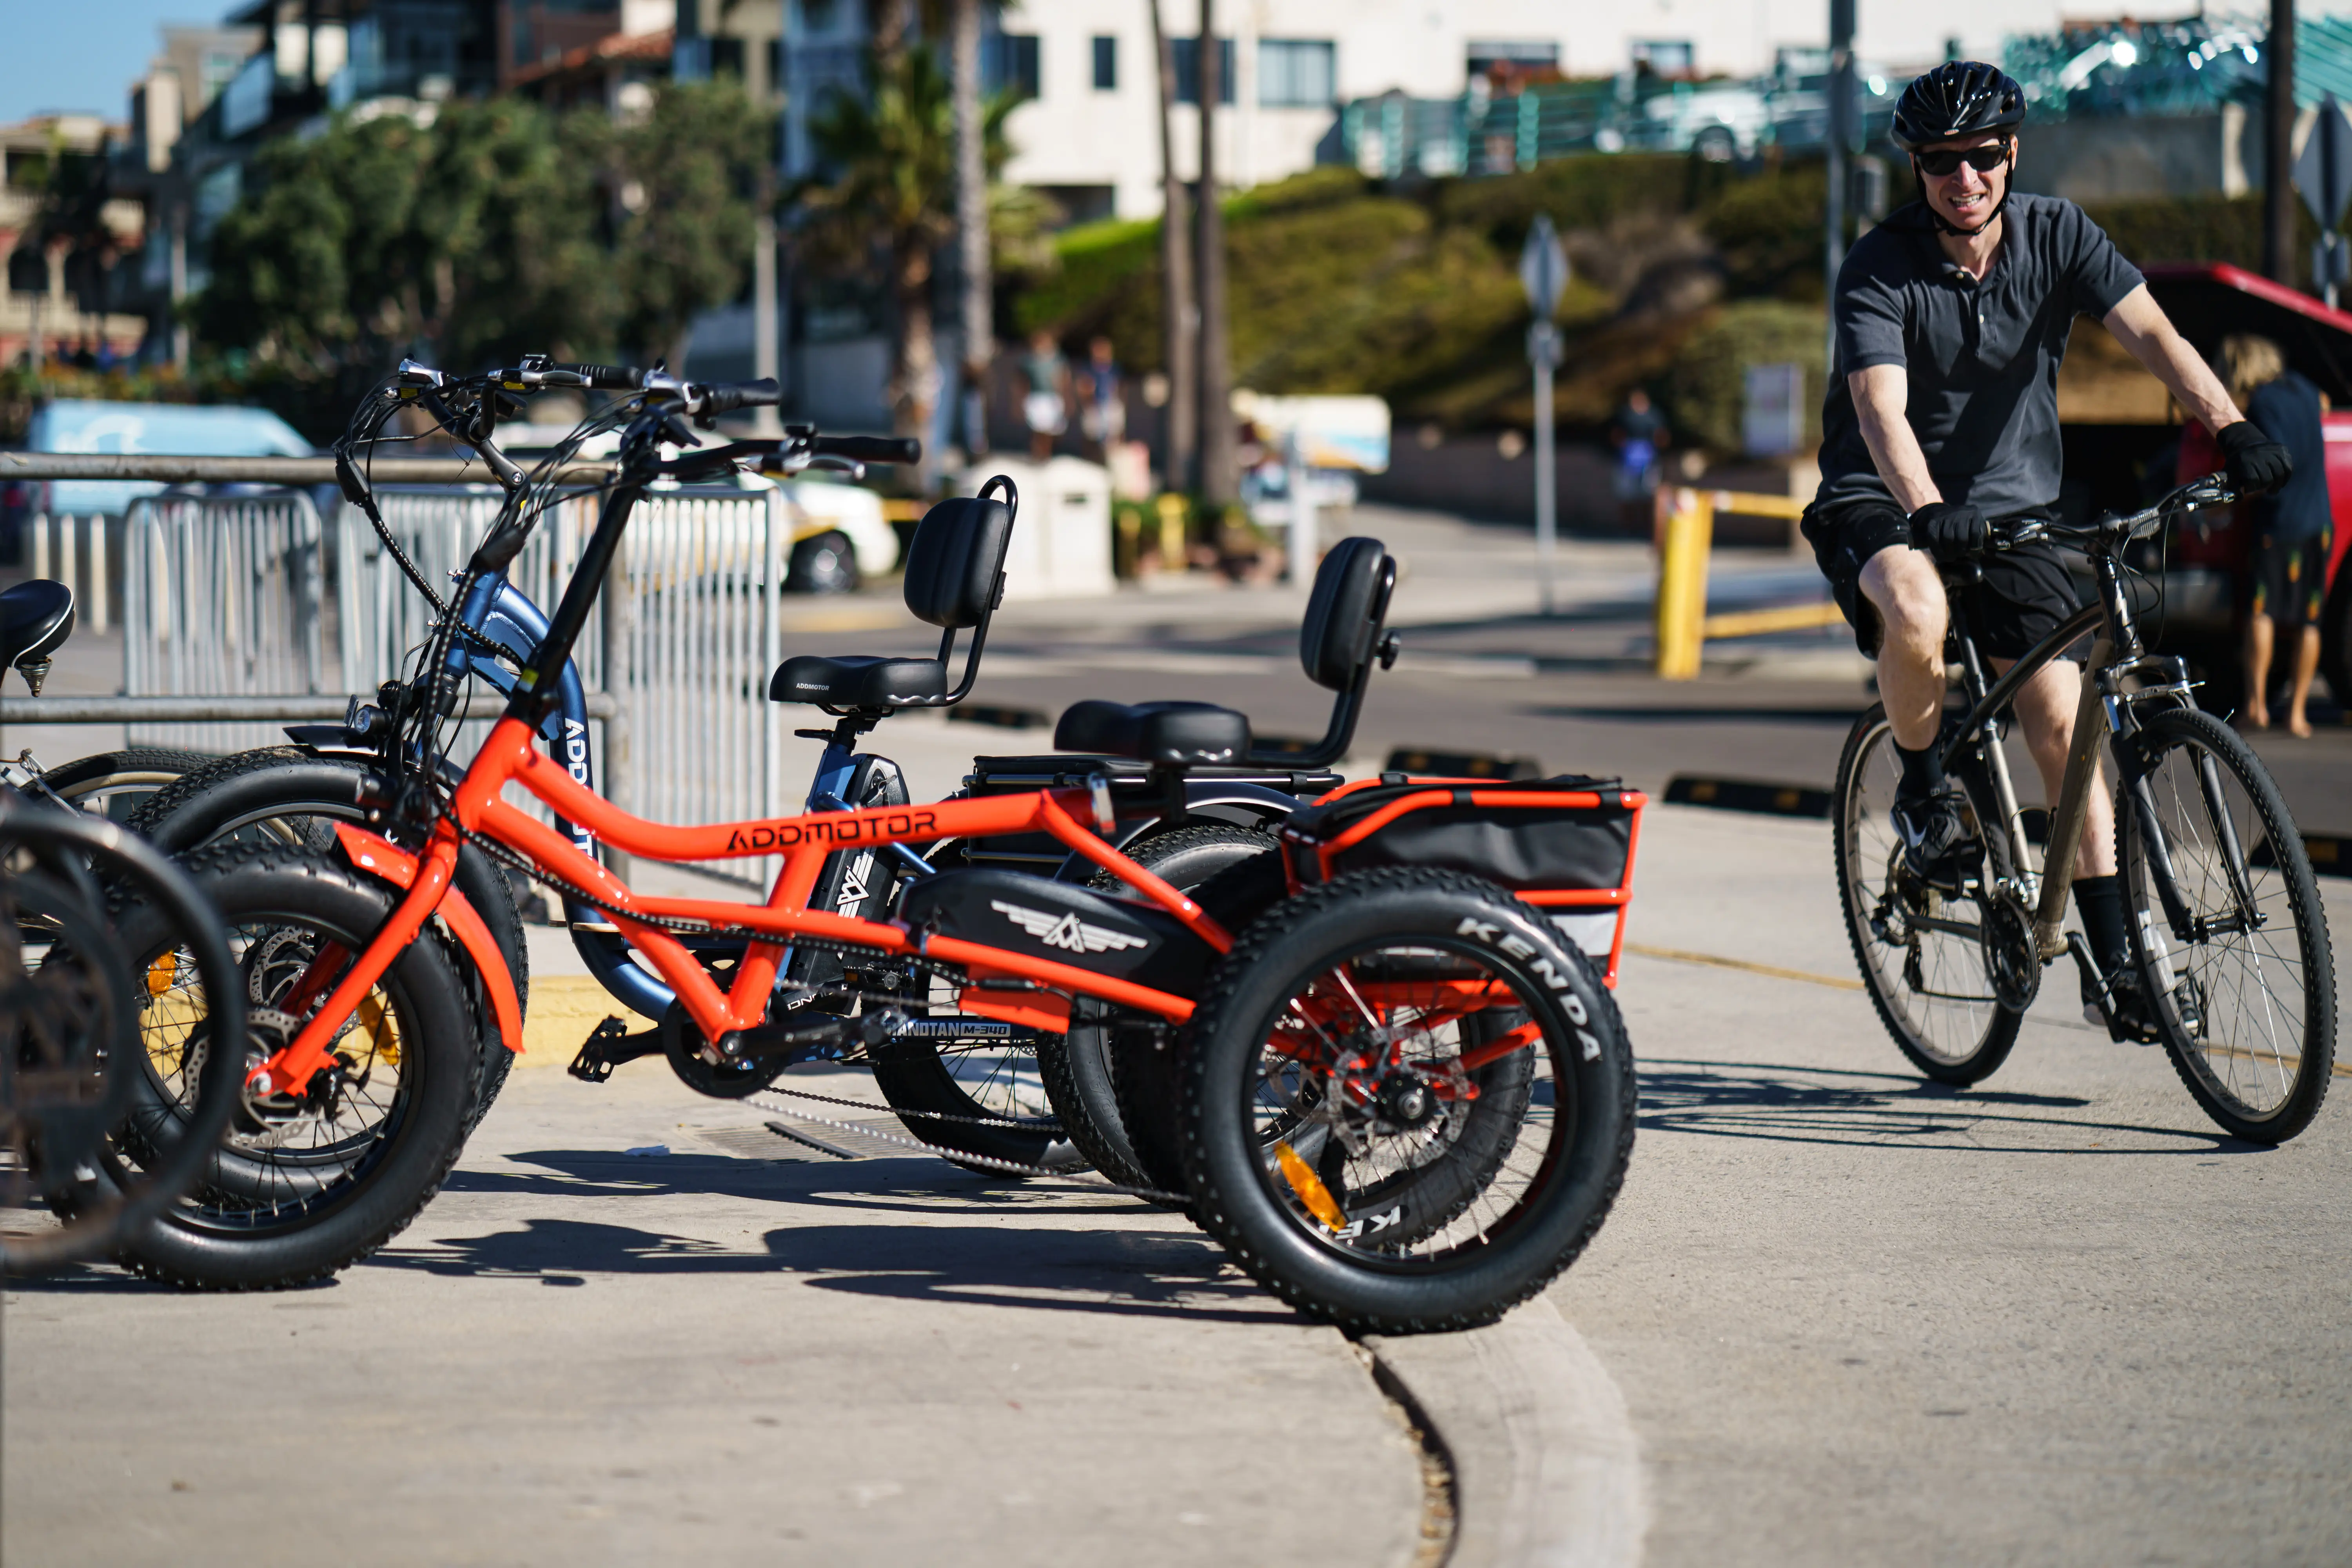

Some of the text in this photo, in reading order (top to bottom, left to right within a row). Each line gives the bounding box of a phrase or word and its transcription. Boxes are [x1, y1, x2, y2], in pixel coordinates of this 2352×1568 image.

[796, 682, 829, 691] ADDMOTOR
[726, 812, 938, 852] ADDMOTOR
[1455, 917, 1601, 1062] KENDA
[964, 1025, 1007, 1035] M-340
